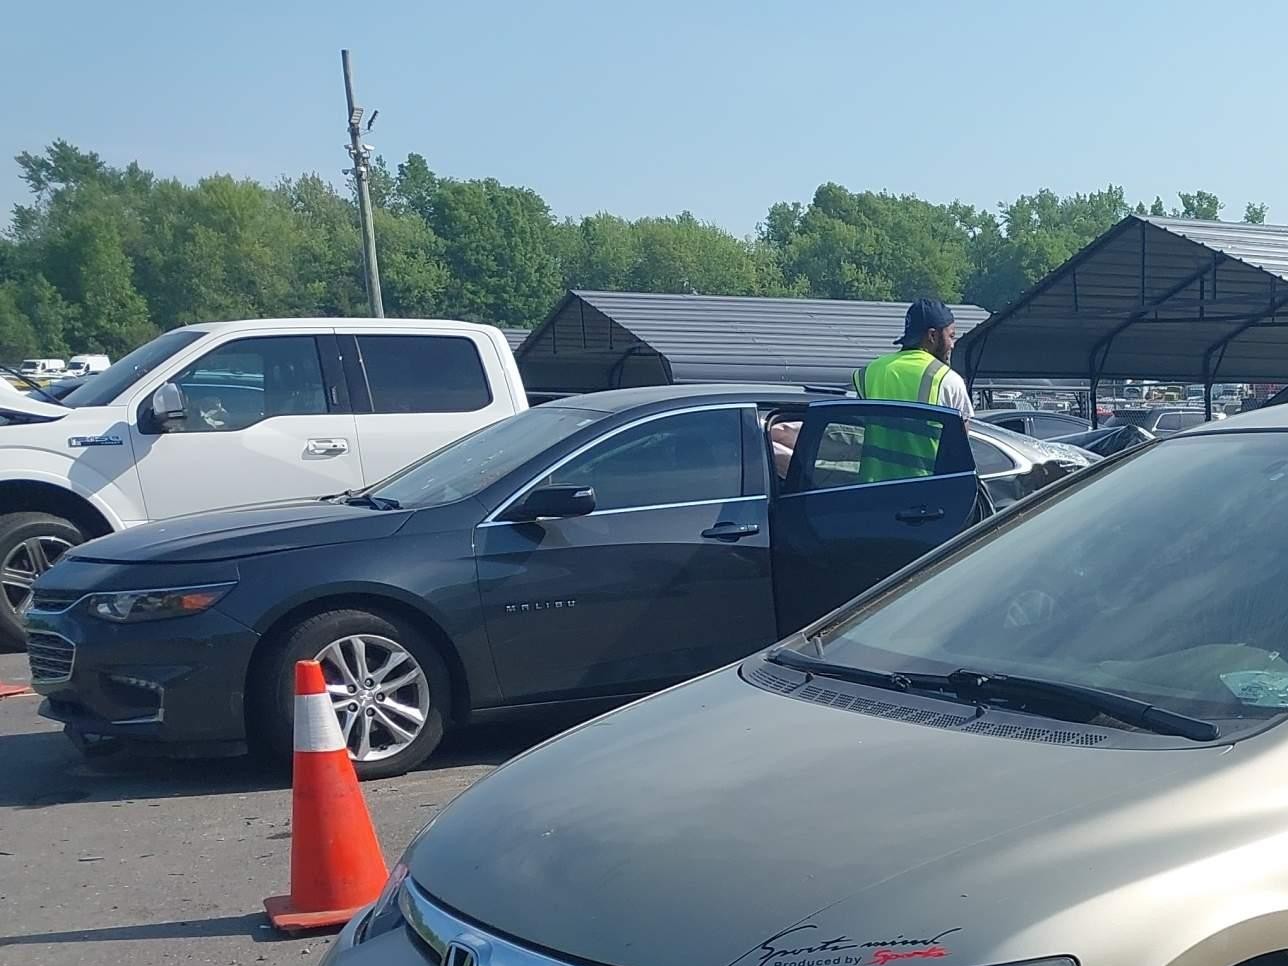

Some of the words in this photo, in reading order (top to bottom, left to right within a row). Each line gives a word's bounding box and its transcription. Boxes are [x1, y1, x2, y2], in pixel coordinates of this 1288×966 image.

[505, 600, 577, 612] MALIBU
[860, 927, 963, 948] mind
[844, 955, 862, 966] by
